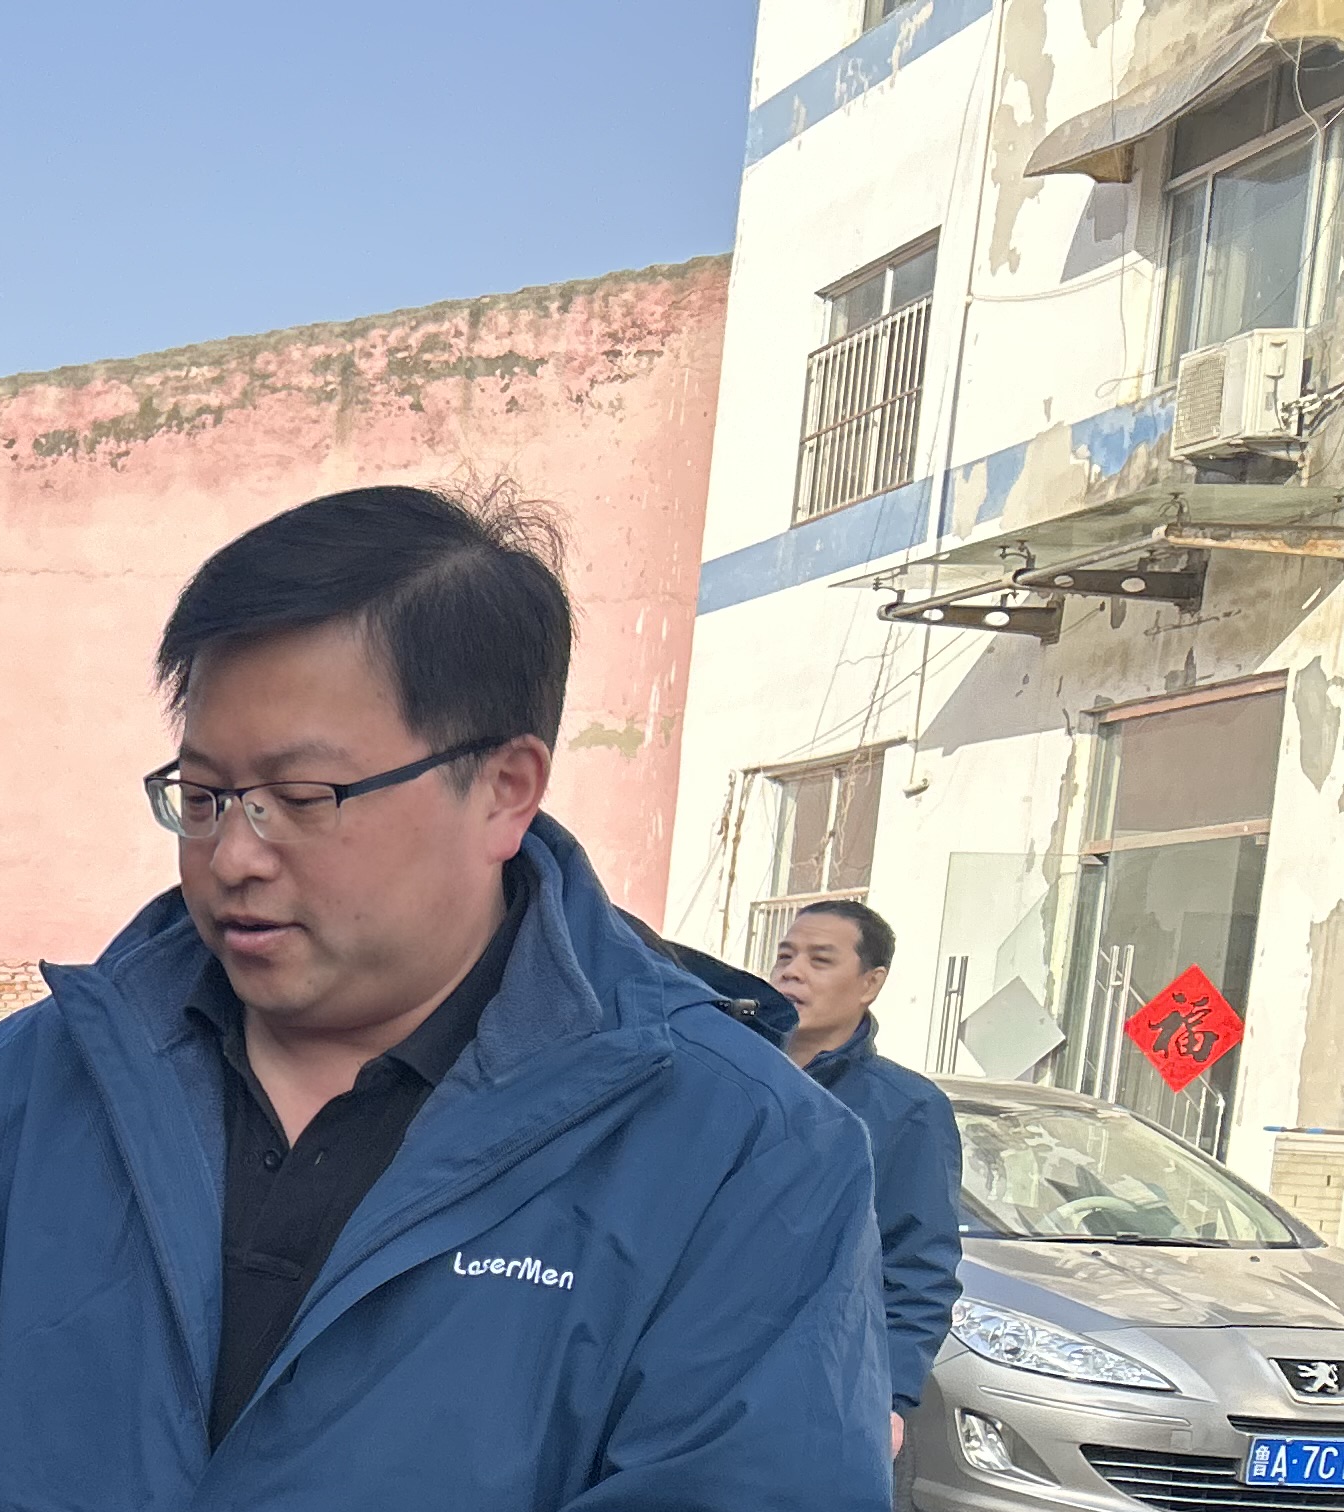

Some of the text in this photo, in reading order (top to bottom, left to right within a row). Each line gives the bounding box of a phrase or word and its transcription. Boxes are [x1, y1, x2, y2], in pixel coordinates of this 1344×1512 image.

[1148, 991, 1219, 1063] 福
[453, 1251, 574, 1290] LaserMen
[1252, 1444, 1344, 1481] 鲁A·7C
